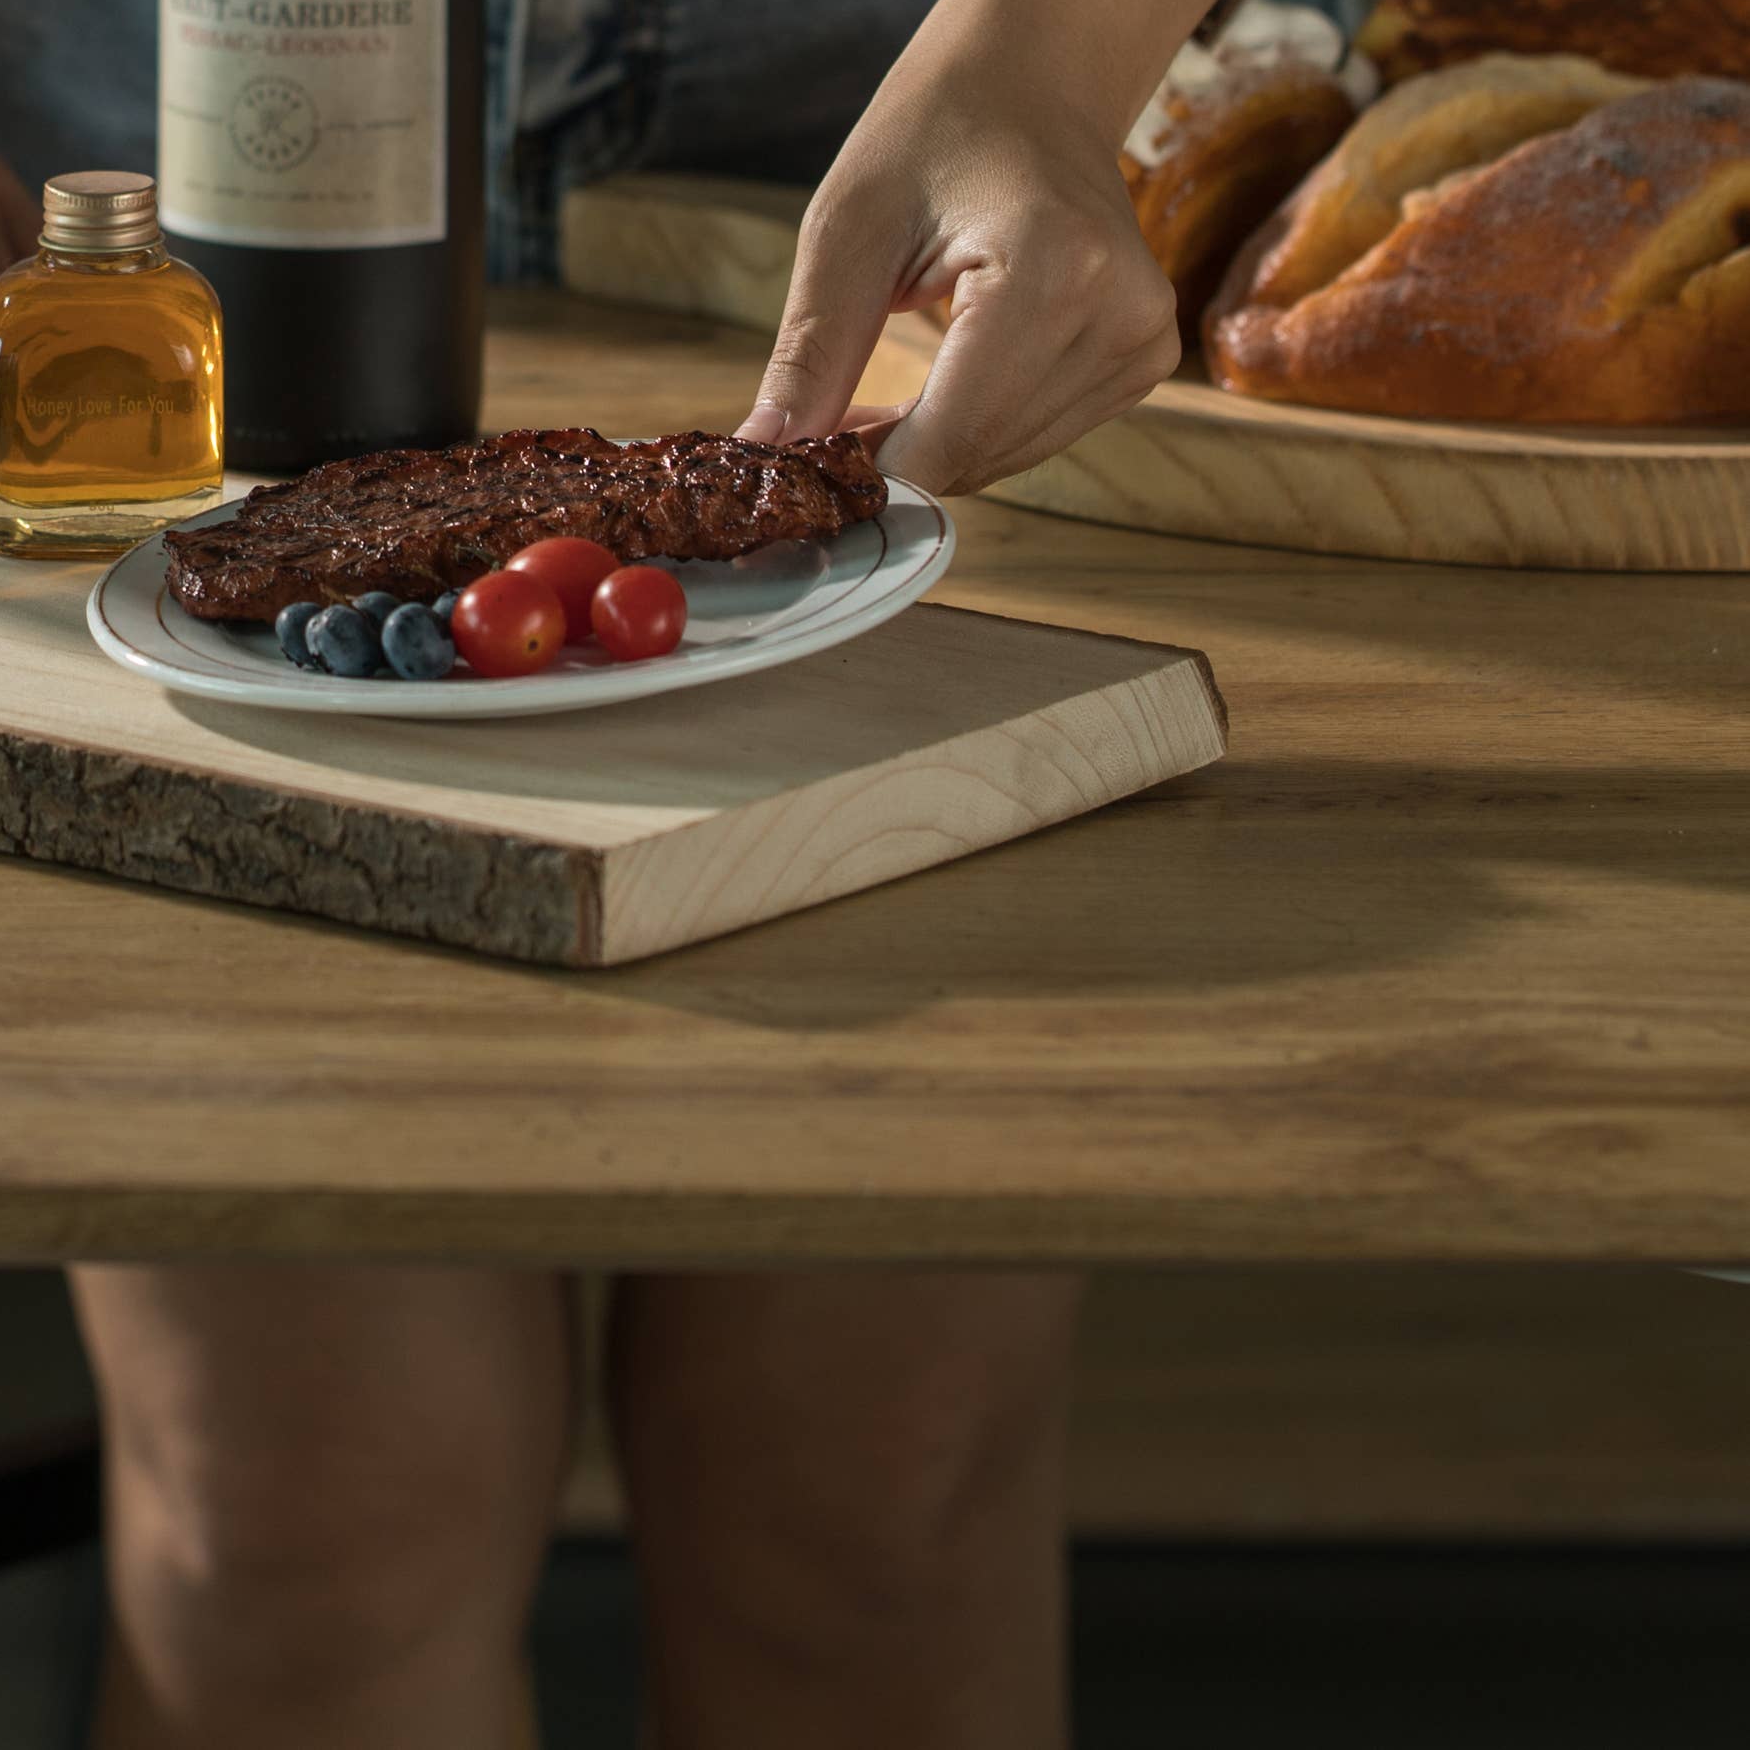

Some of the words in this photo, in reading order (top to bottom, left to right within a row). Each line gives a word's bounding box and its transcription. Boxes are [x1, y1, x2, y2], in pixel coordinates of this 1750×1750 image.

[26, 396, 73, 419] Honey
[78, 395, 112, 416] Love
[118, 395, 143, 415] For
[148, 394, 175, 416] You
